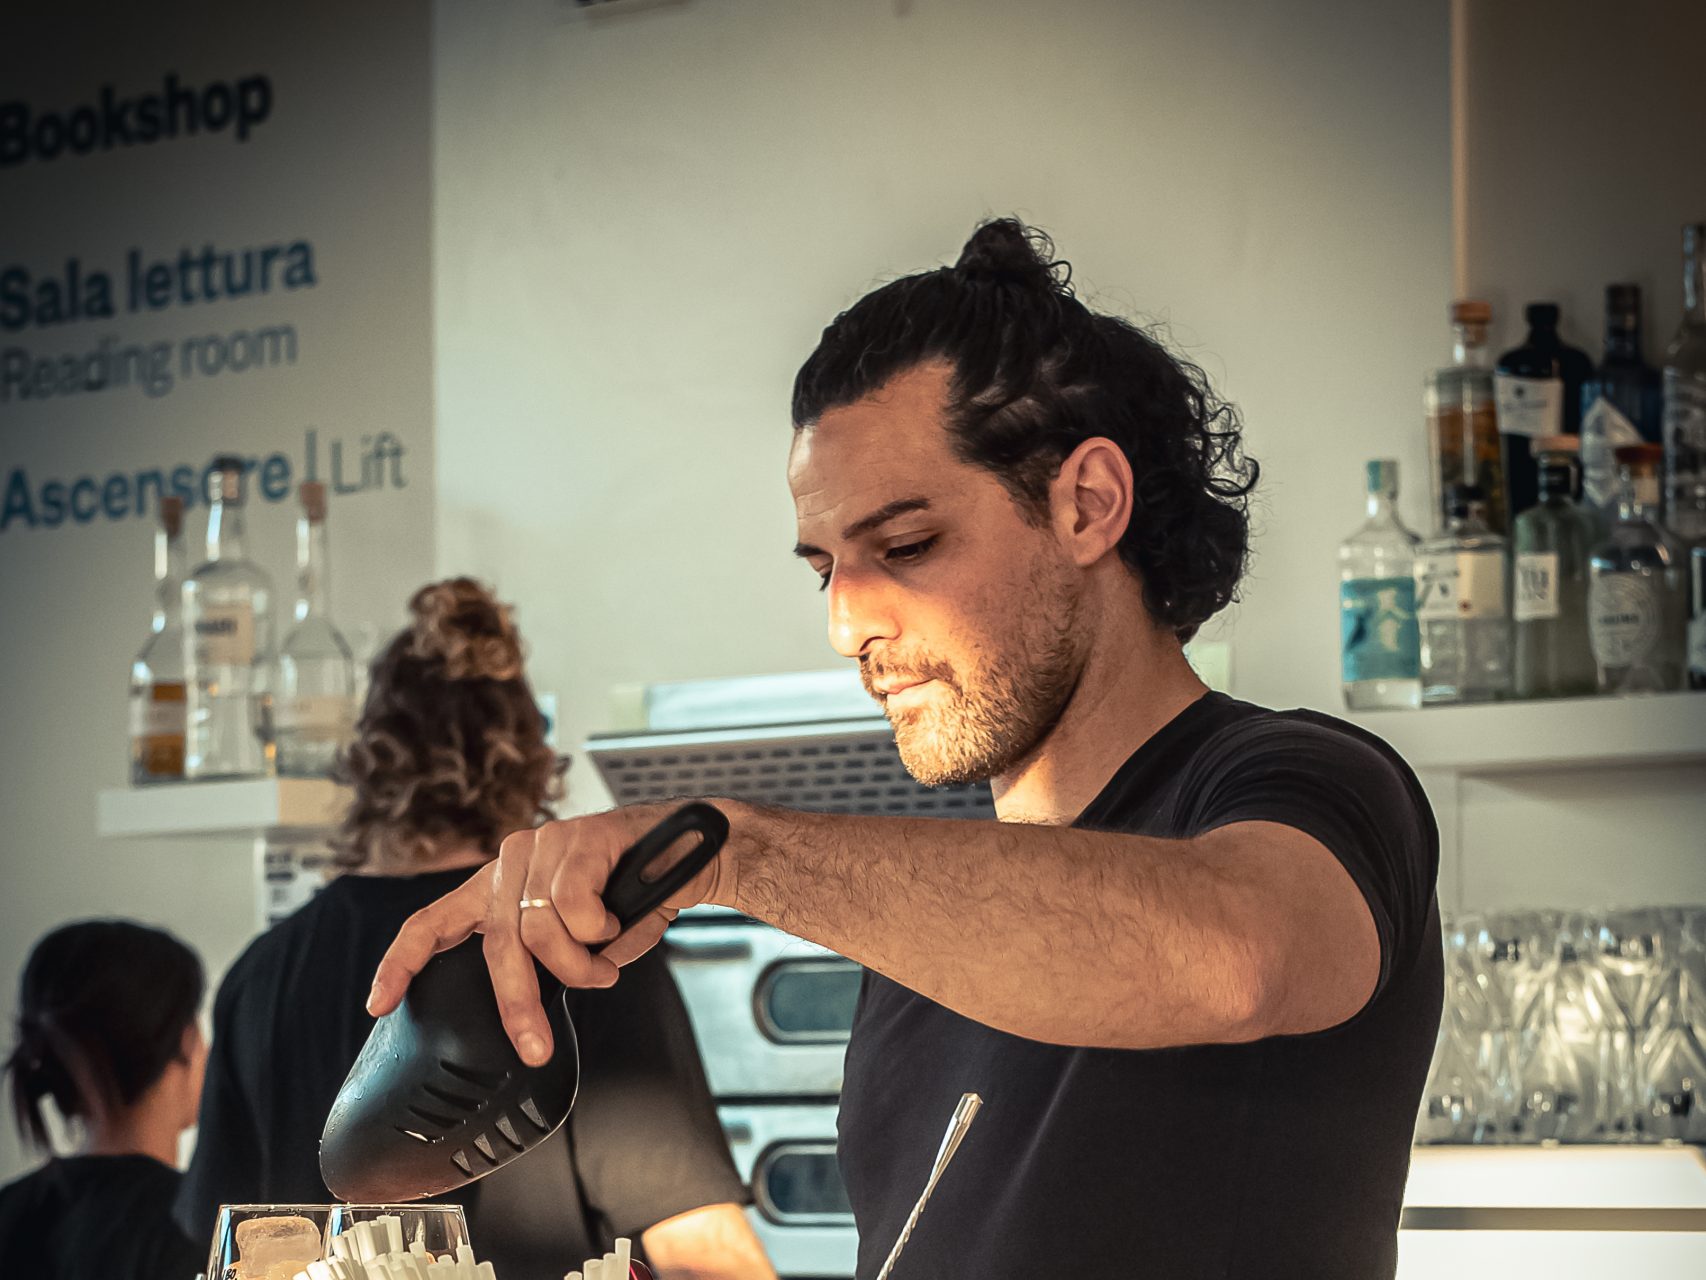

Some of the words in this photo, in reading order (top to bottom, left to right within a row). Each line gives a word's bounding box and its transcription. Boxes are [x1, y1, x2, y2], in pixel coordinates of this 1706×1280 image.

[0, 72, 274, 167] Bookshop
[0, 258, 115, 331] Sala
[127, 240, 317, 313] lettura
[0, 335, 174, 400] Reading
[180, 323, 298, 379] room
[331, 431, 408, 494] Lift
